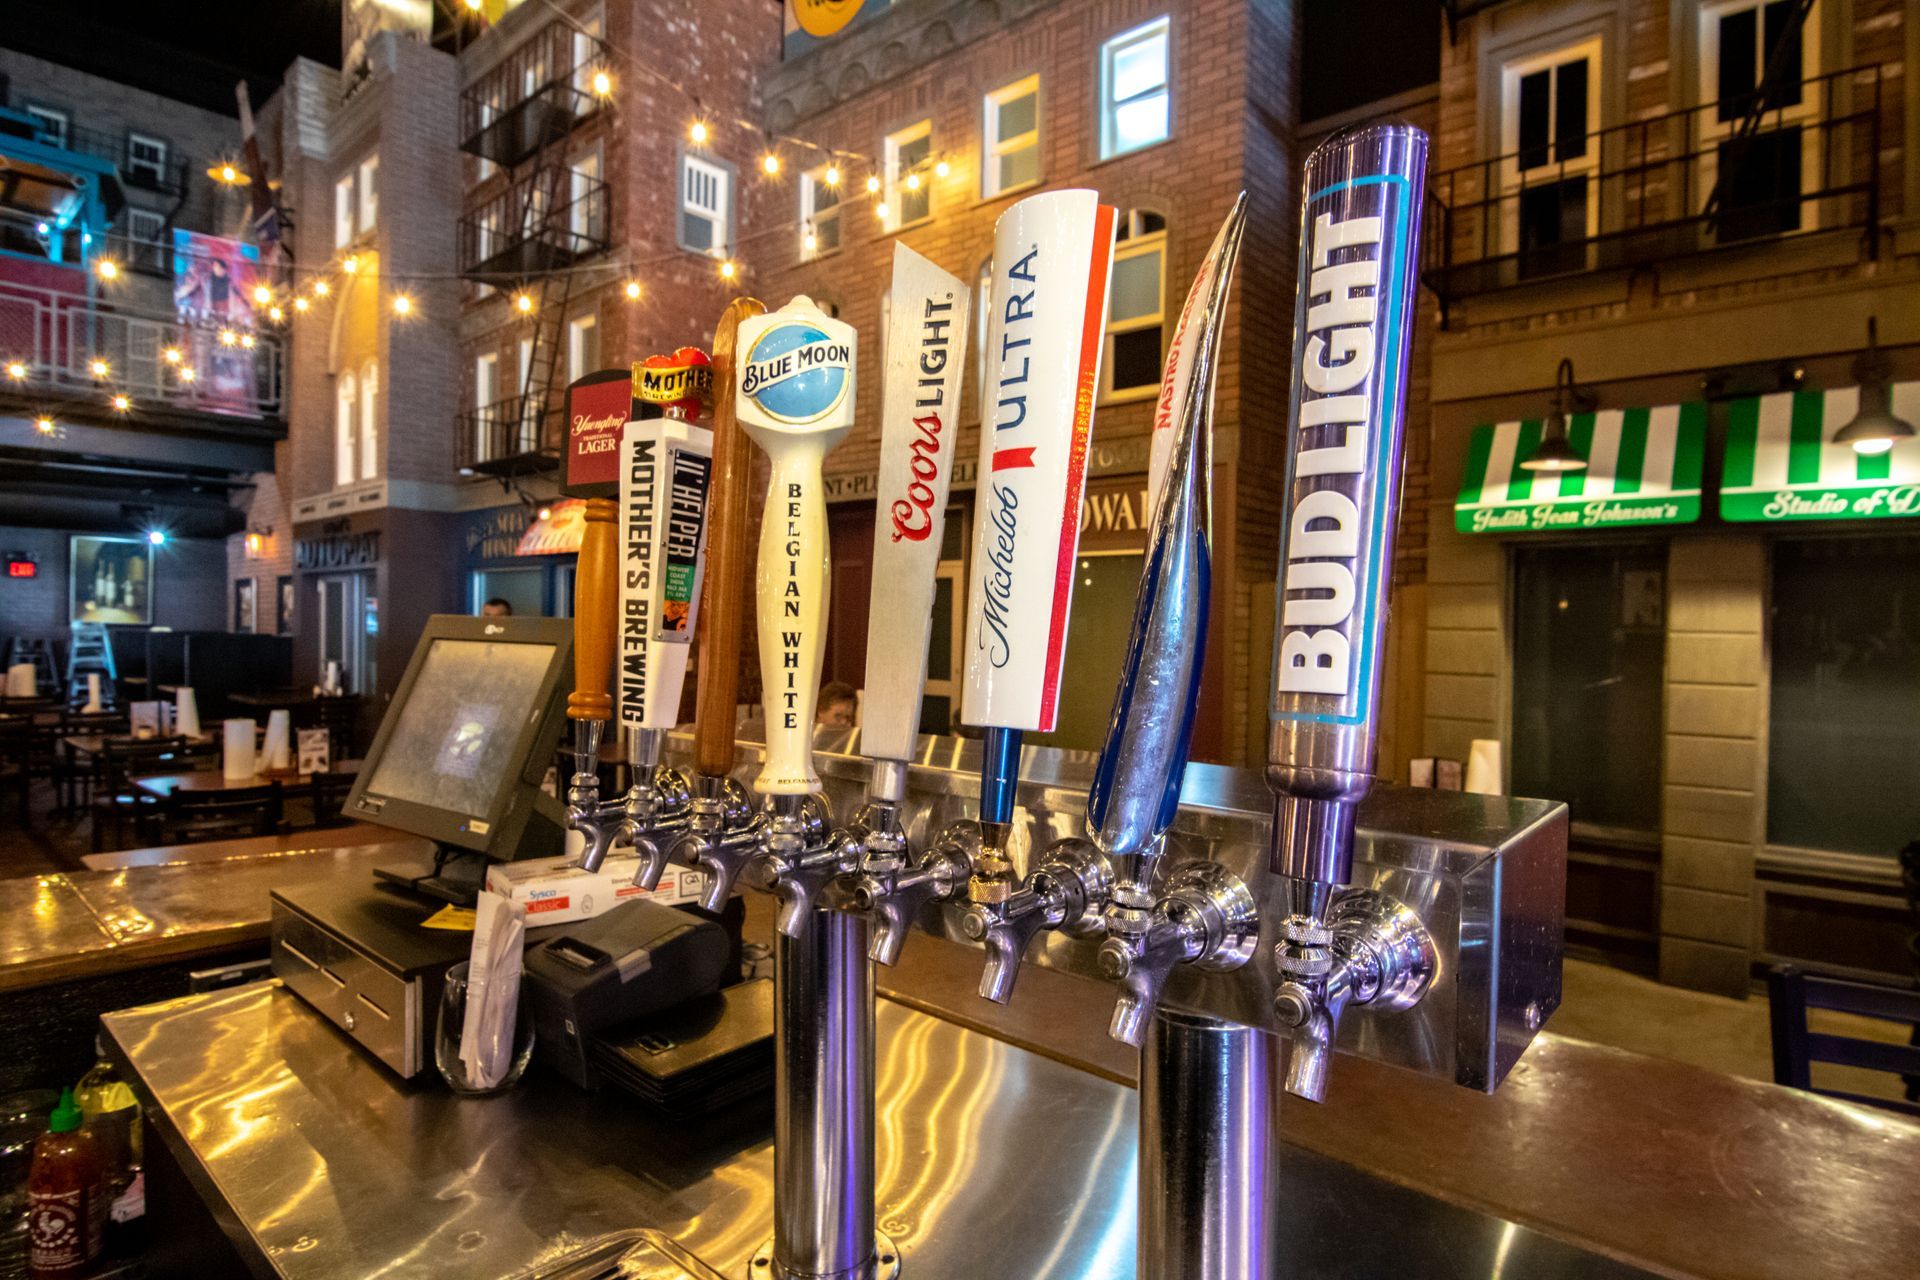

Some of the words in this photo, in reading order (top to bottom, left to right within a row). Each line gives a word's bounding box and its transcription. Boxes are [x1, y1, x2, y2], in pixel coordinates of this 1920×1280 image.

[742, 355, 792, 393] BLUE
[798, 344, 850, 369] MOON
[996, 247, 1040, 432] ULTRA
[1295, 211, 1382, 480] LIGHT
[571, 411, 628, 437] Yuengling
[1157, 350, 1180, 430] NASTRO
[578, 438, 616, 455] LAGER
[890, 411, 943, 544] Coors
[626, 439, 656, 591] MOTHER'S
[668, 483, 702, 559] HELPER
[785, 482, 802, 617] BELGIAN
[1472, 507, 1528, 533] Judith
[1532, 502, 1580, 529] Jean
[1583, 499, 1679, 527] Johnson's
[1763, 490, 1849, 519] Studio
[1852, 488, 1890, 515] of
[979, 484, 1019, 669] Michelob
[1278, 489, 1359, 695] BUD
[622, 600, 649, 723] BREWING
[781, 632, 802, 729] WHITE
[529, 888, 557, 901] Sysco
